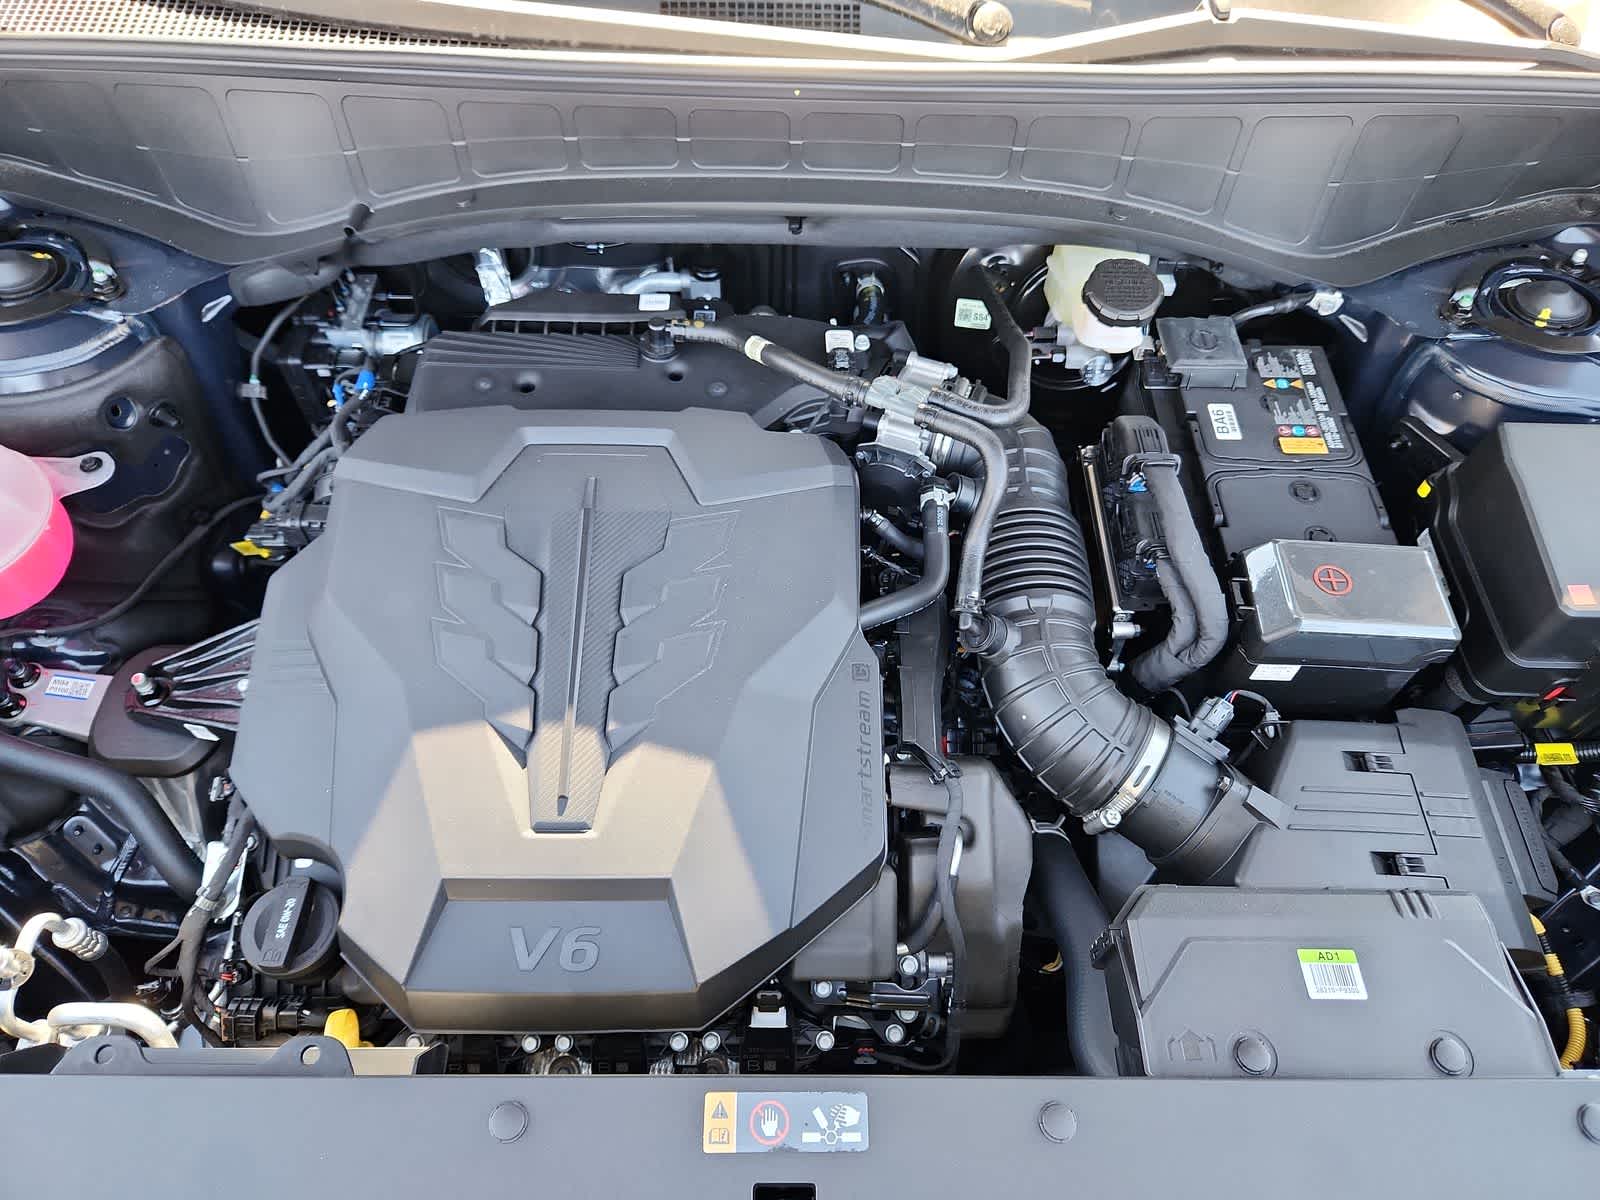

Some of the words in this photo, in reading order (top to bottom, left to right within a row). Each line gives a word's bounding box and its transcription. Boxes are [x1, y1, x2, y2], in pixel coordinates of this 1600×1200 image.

[1213, 409, 1230, 434] BA6
[275, 922, 288, 939] SAE
[508, 925, 602, 973] V6
[1318, 951, 1340, 961] AD1
